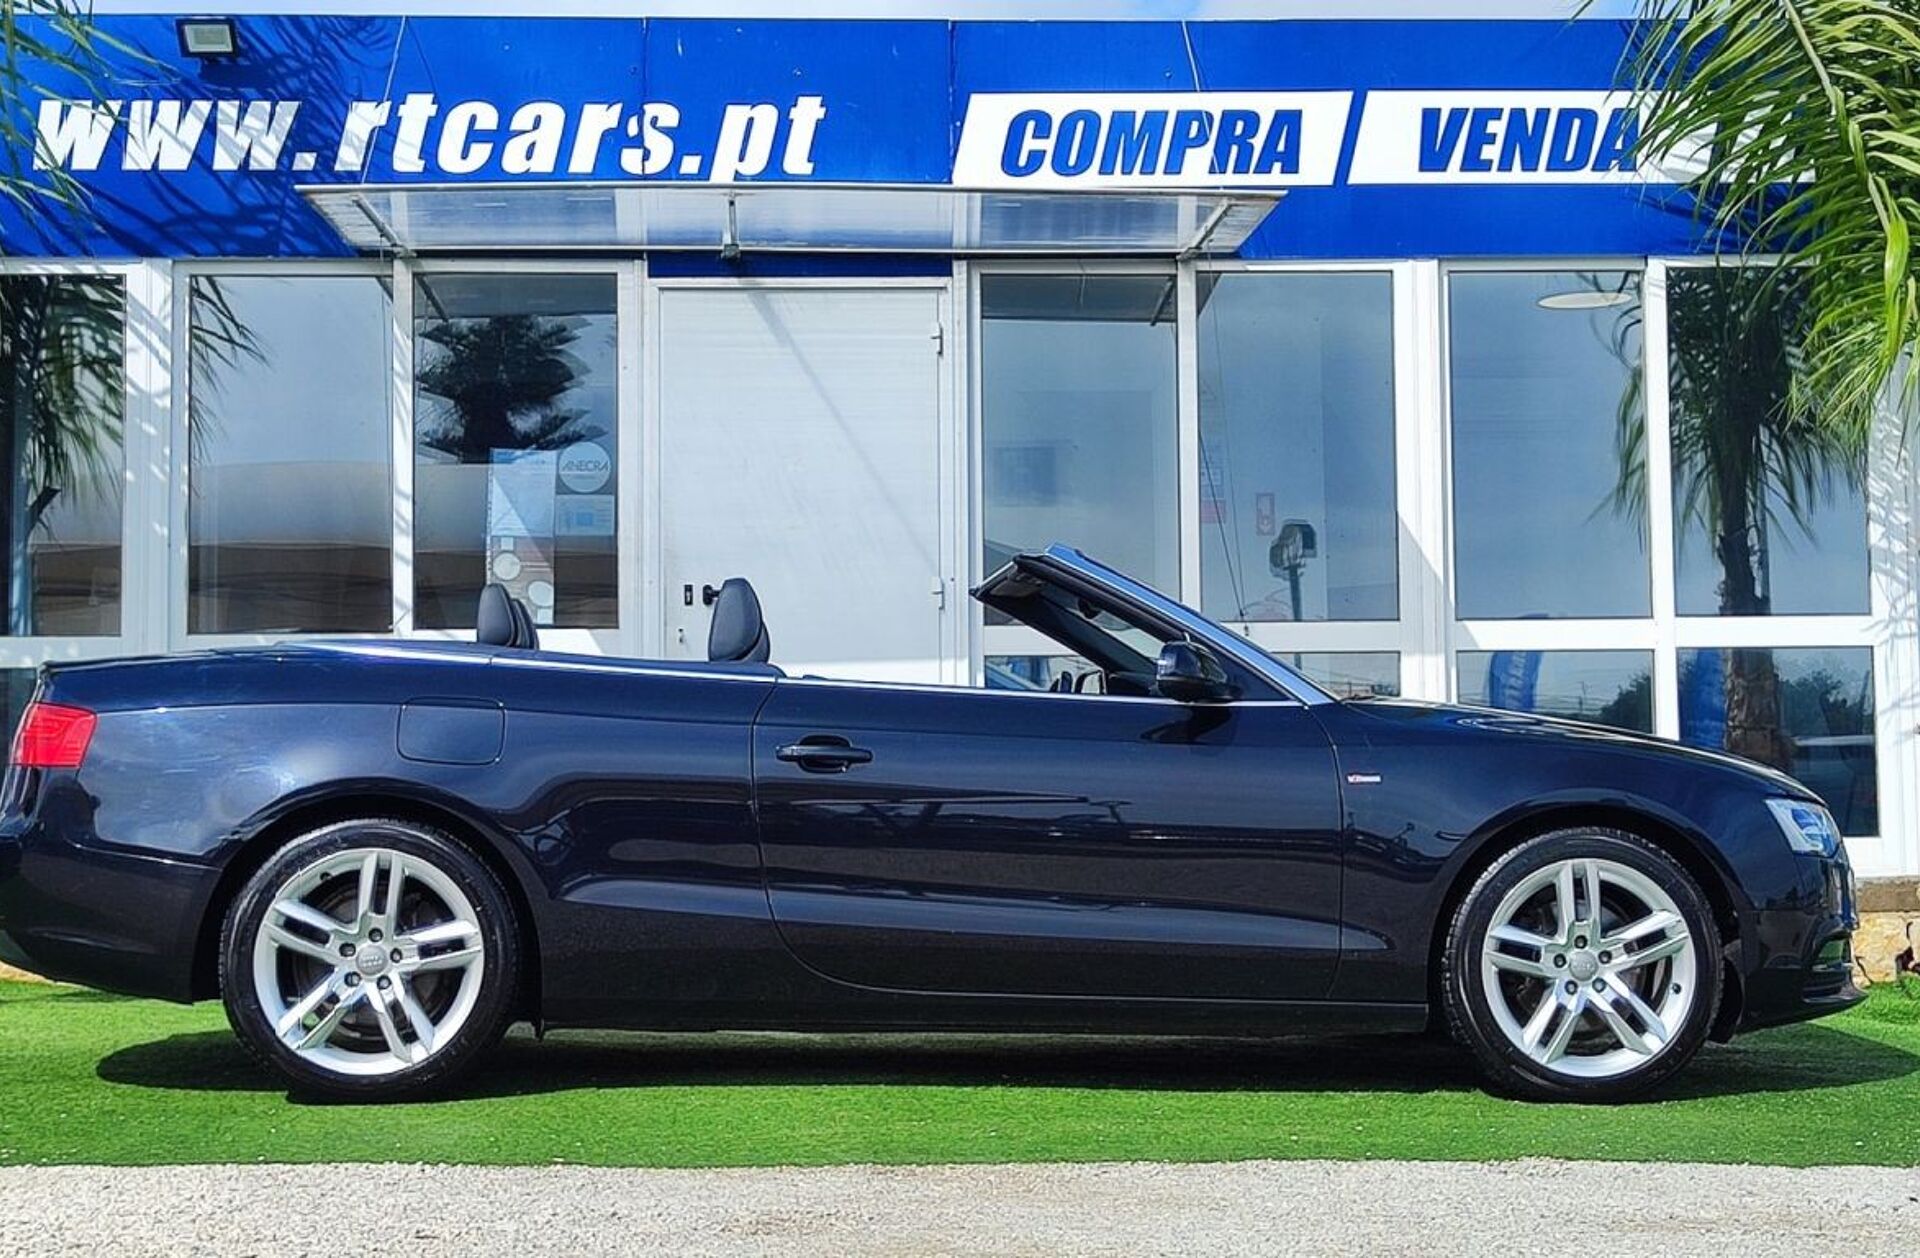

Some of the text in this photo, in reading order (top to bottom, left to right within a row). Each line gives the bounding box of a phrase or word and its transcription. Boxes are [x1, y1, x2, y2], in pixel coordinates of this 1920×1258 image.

[33, 93, 825, 182] www.rtcars.pt
[1000, 108, 1302, 177] COMPRA
[1418, 107, 1640, 173] VENDA
